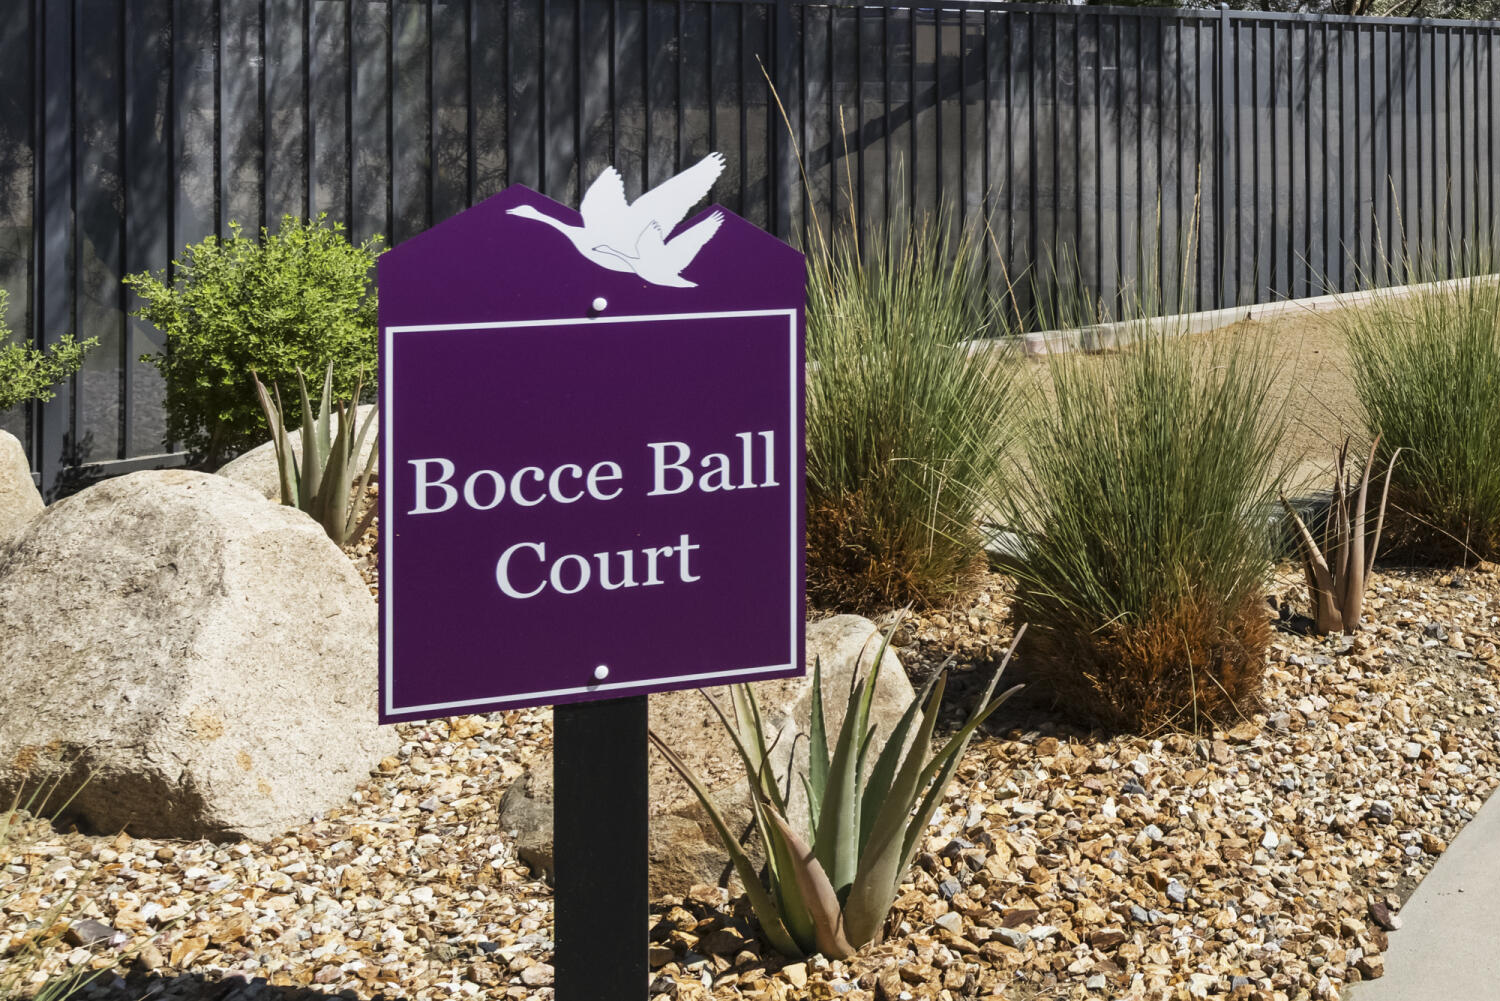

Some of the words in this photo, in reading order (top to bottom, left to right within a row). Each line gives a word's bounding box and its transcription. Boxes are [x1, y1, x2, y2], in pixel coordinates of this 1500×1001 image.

[407, 457, 623, 515] Bocce
[646, 430, 780, 496] Ball
[496, 534, 701, 599] Court
